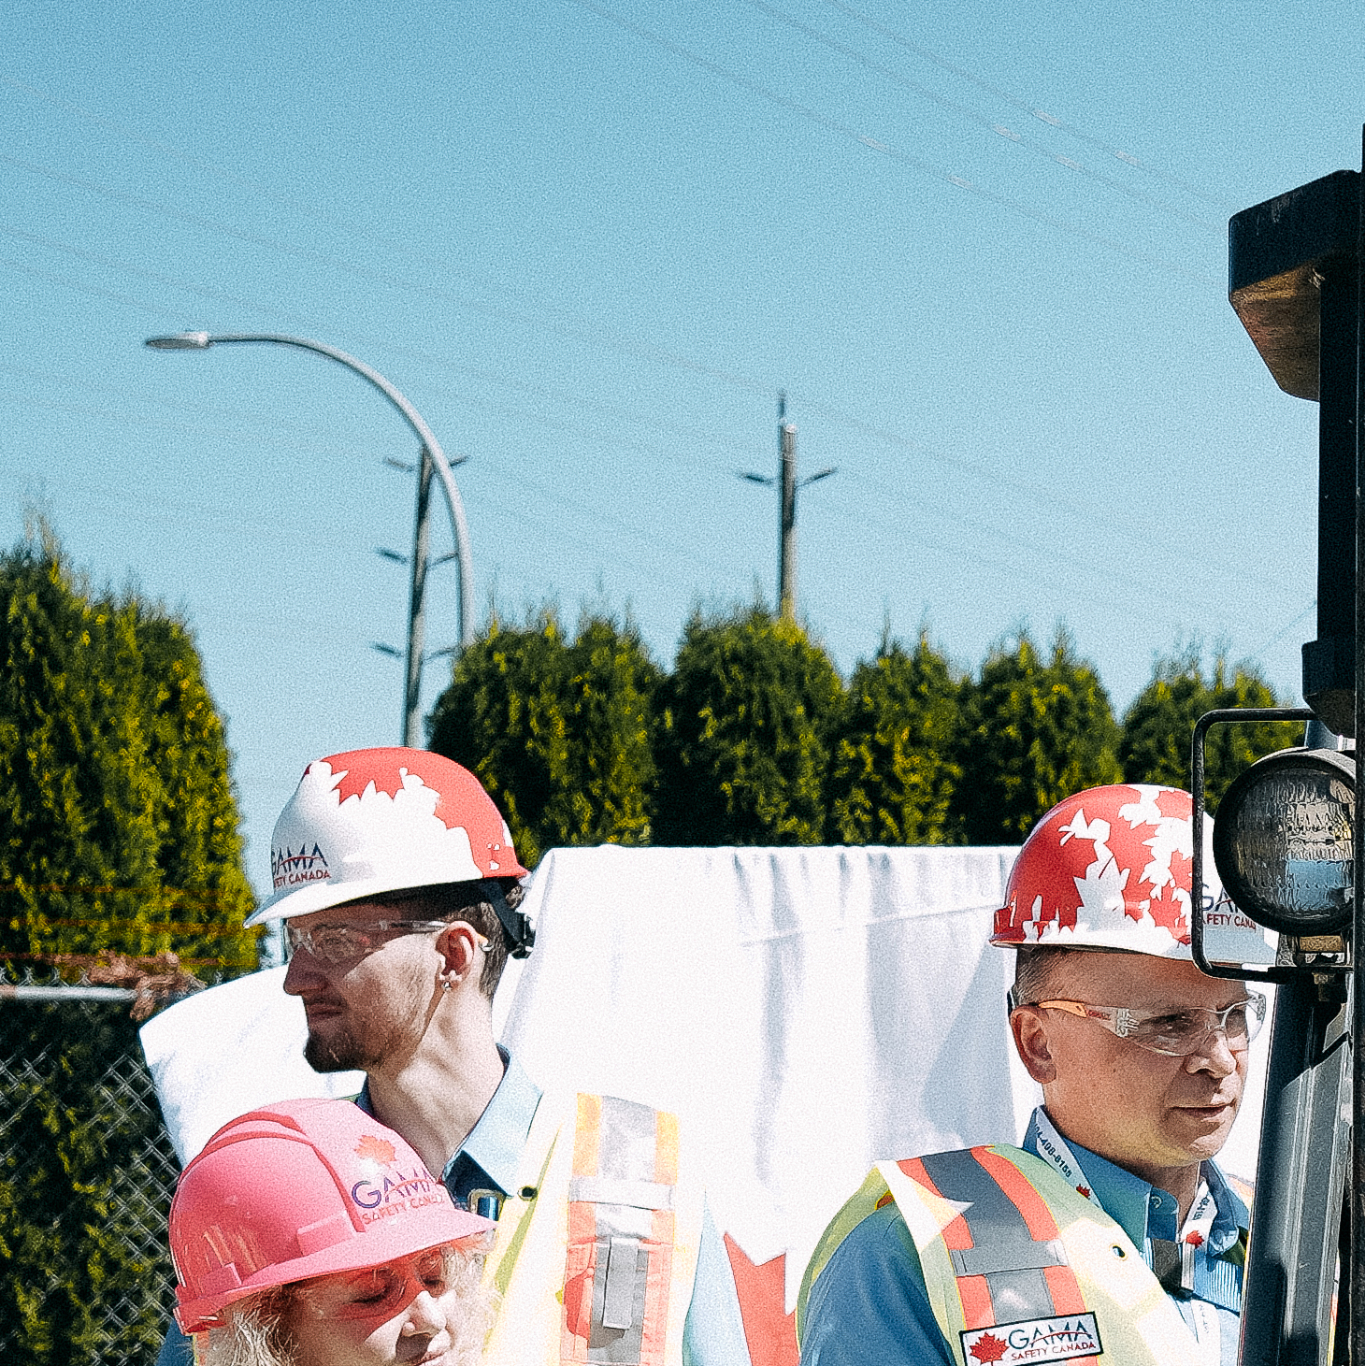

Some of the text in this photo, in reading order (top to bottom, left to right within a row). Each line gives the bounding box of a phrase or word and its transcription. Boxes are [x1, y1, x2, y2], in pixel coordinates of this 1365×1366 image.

[288, 869, 332, 885] CANADA
[362, 1202, 407, 1225] SAFETY
[1008, 1320, 1094, 1350] GAMA
[1011, 1341, 1097, 1361] SAFETY CANADA
